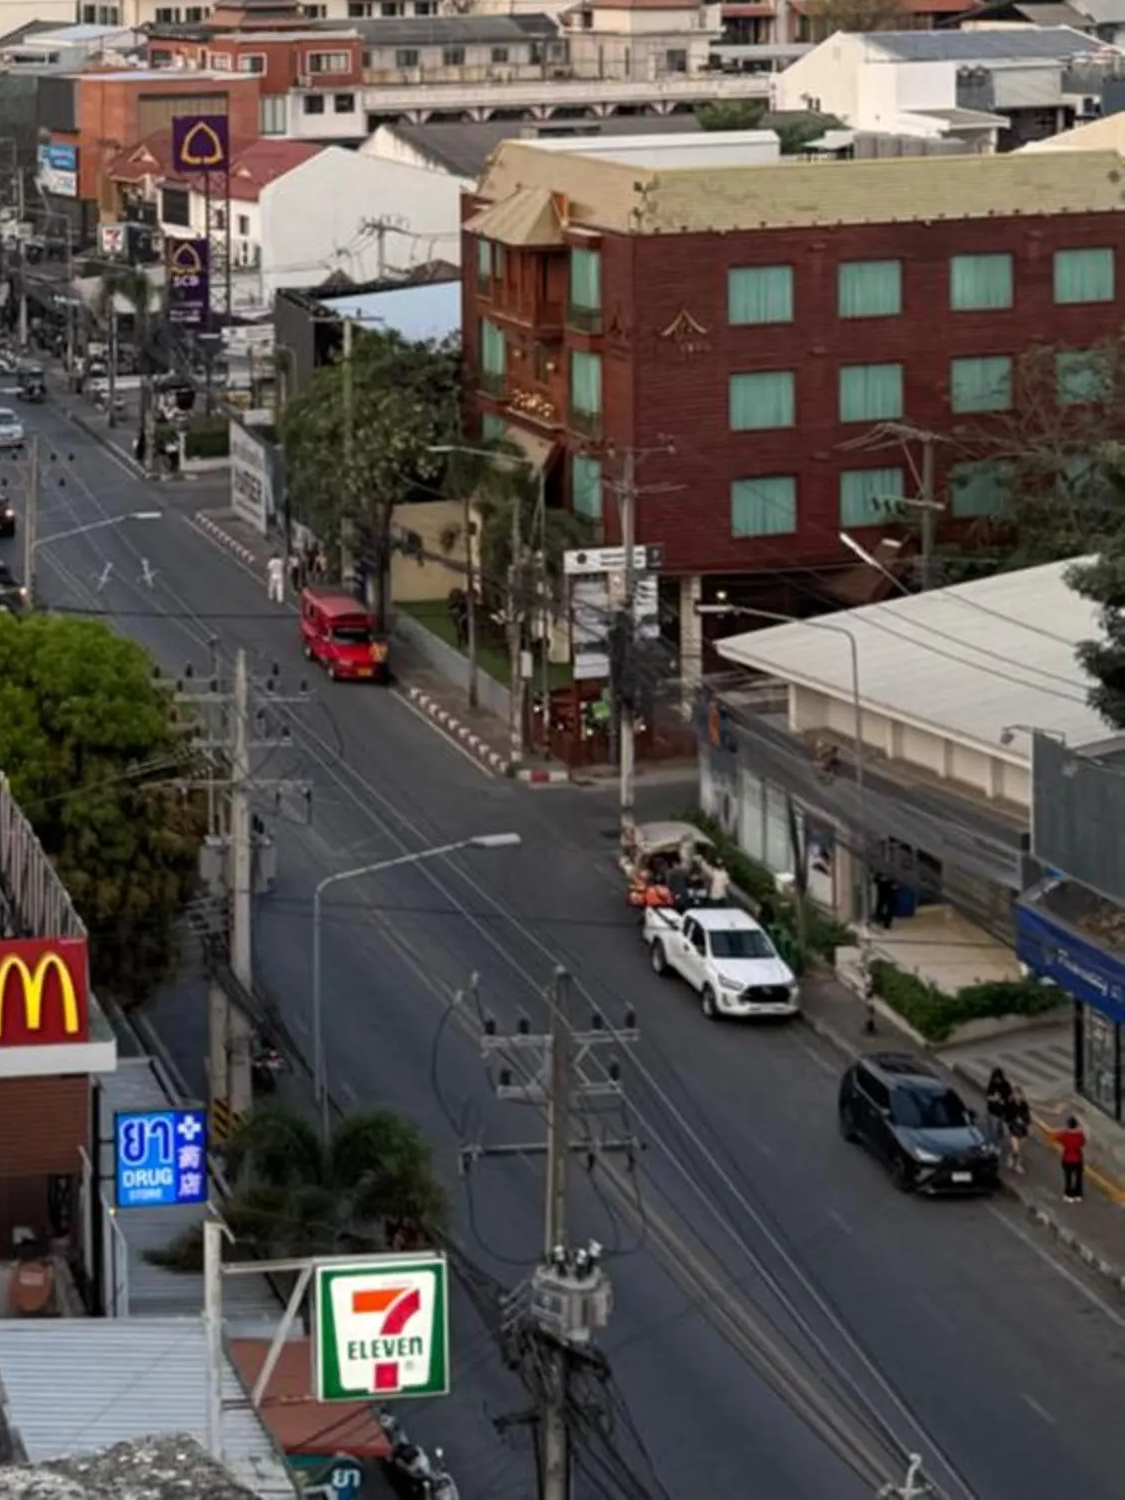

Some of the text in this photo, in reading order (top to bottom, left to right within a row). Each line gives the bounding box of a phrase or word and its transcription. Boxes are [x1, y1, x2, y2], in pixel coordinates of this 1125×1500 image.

[121, 1118, 173, 1164] ยา
[122, 1167, 173, 1187] DRUG
[352, 1286, 420, 1335] 7
